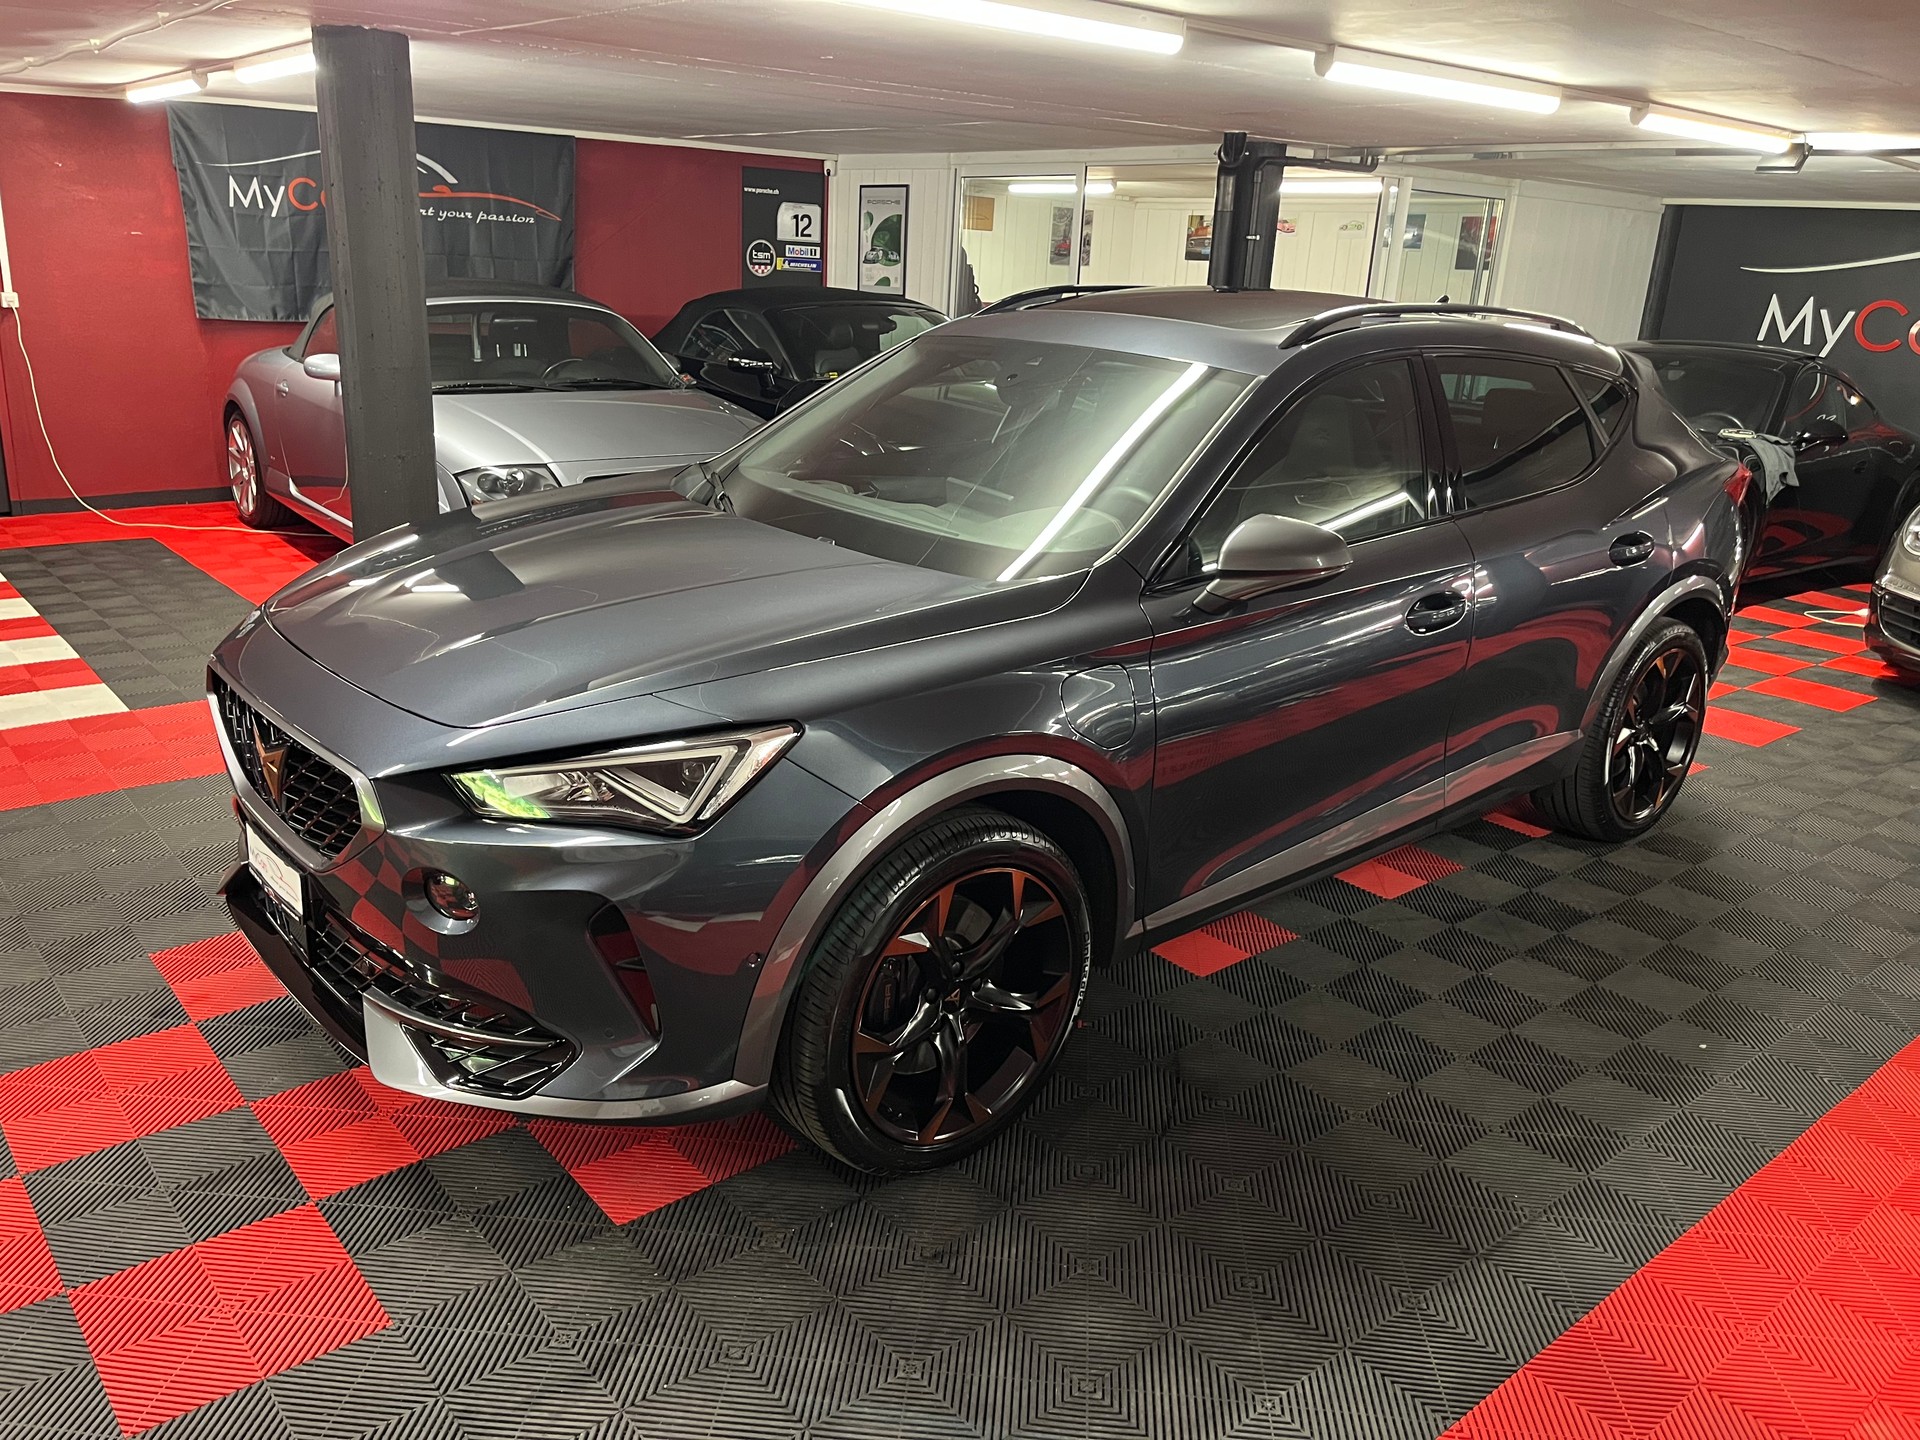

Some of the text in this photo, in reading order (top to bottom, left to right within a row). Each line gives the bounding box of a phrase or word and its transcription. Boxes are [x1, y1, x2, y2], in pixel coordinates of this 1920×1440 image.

[437, 208, 473, 222] your
[476, 210, 536, 225] passion
[791, 213, 812, 238] 12
[752, 249, 771, 260] tsm
[787, 246, 809, 256] Mobil
